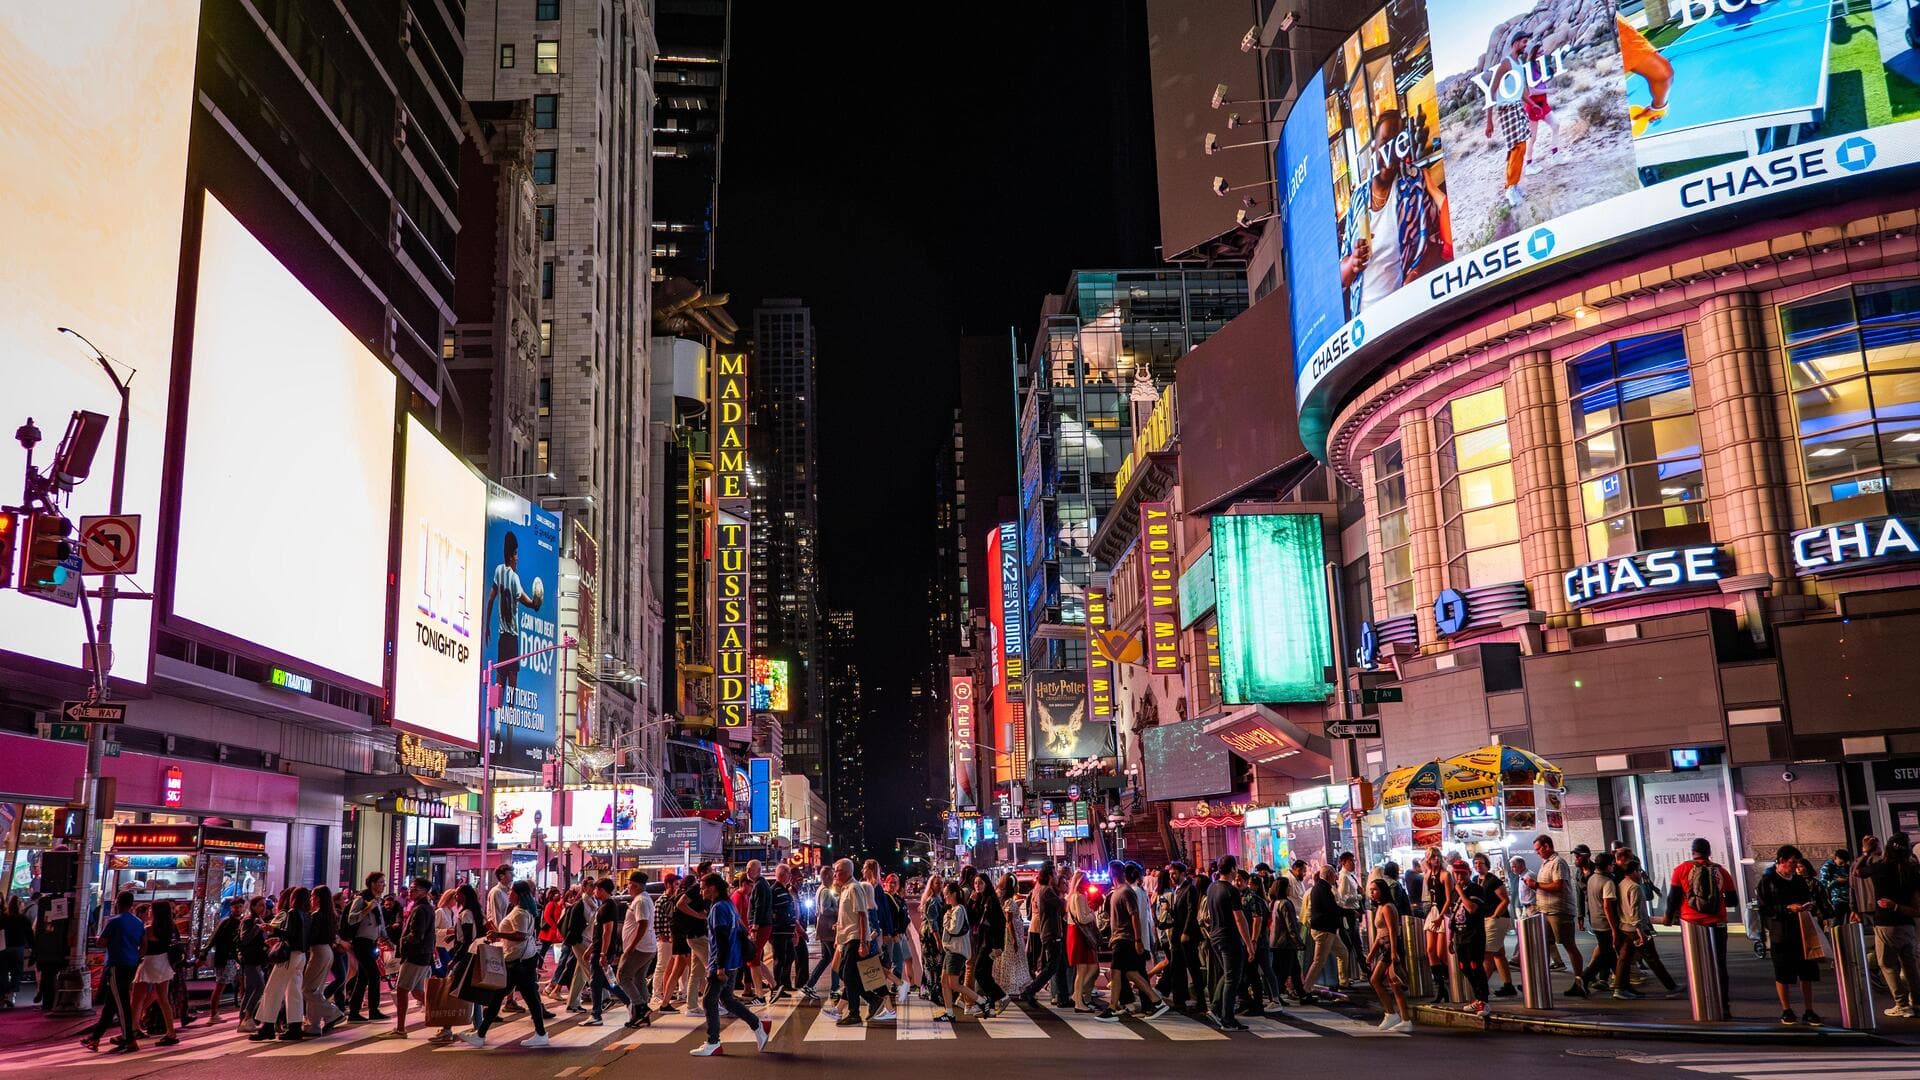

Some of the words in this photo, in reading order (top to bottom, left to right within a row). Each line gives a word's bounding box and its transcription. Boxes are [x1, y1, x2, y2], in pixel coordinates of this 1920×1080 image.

[1471, 45, 1570, 111] Your
[1288, 155, 1308, 204] Later
[1349, 130, 1411, 189] Live
[1680, 149, 1829, 208] CHASE
[1430, 241, 1522, 300] CHASE
[1312, 332, 1350, 380] CHASE
[719, 354, 744, 497] MADAME
[1001, 524, 1016, 550] NEW
[1147, 509, 1173, 607] VICTORY
[1564, 547, 1721, 603] CHASE
[416, 621, 457, 659] TONIGHT
[457, 643, 470, 664] 8P
[534, 617, 544, 634] YOU
[544, 621, 555, 638] BEAT
[1004, 600, 1021, 654] STUDIOS
[1155, 622, 1177, 668] NEW
[520, 630, 554, 675] D10S?
[1007, 658, 1023, 690] DUE
[515, 687, 538, 710] TICKETS
[1035, 682, 1060, 698] Harry
[1060, 679, 1086, 696] Potter
[1093, 680, 1110, 715] NEW
[1373, 690, 1378, 702] 7
[60, 725, 66, 738] 7
[72, 708, 91, 717] ONE
[98, 709, 118, 717] WAY
[957, 704, 972, 762] REGAL
[1332, 725, 1350, 734] ONE
[1355, 725, 1373, 733] WAY
[401, 734, 449, 779] Subway
[1220, 727, 1284, 752] Subway
[1447, 785, 1494, 801] SABRETT
[1654, 794, 1677, 805] STEVE
[1678, 792, 1710, 804] MADDEN
[1009, 828, 1021, 836] 25
